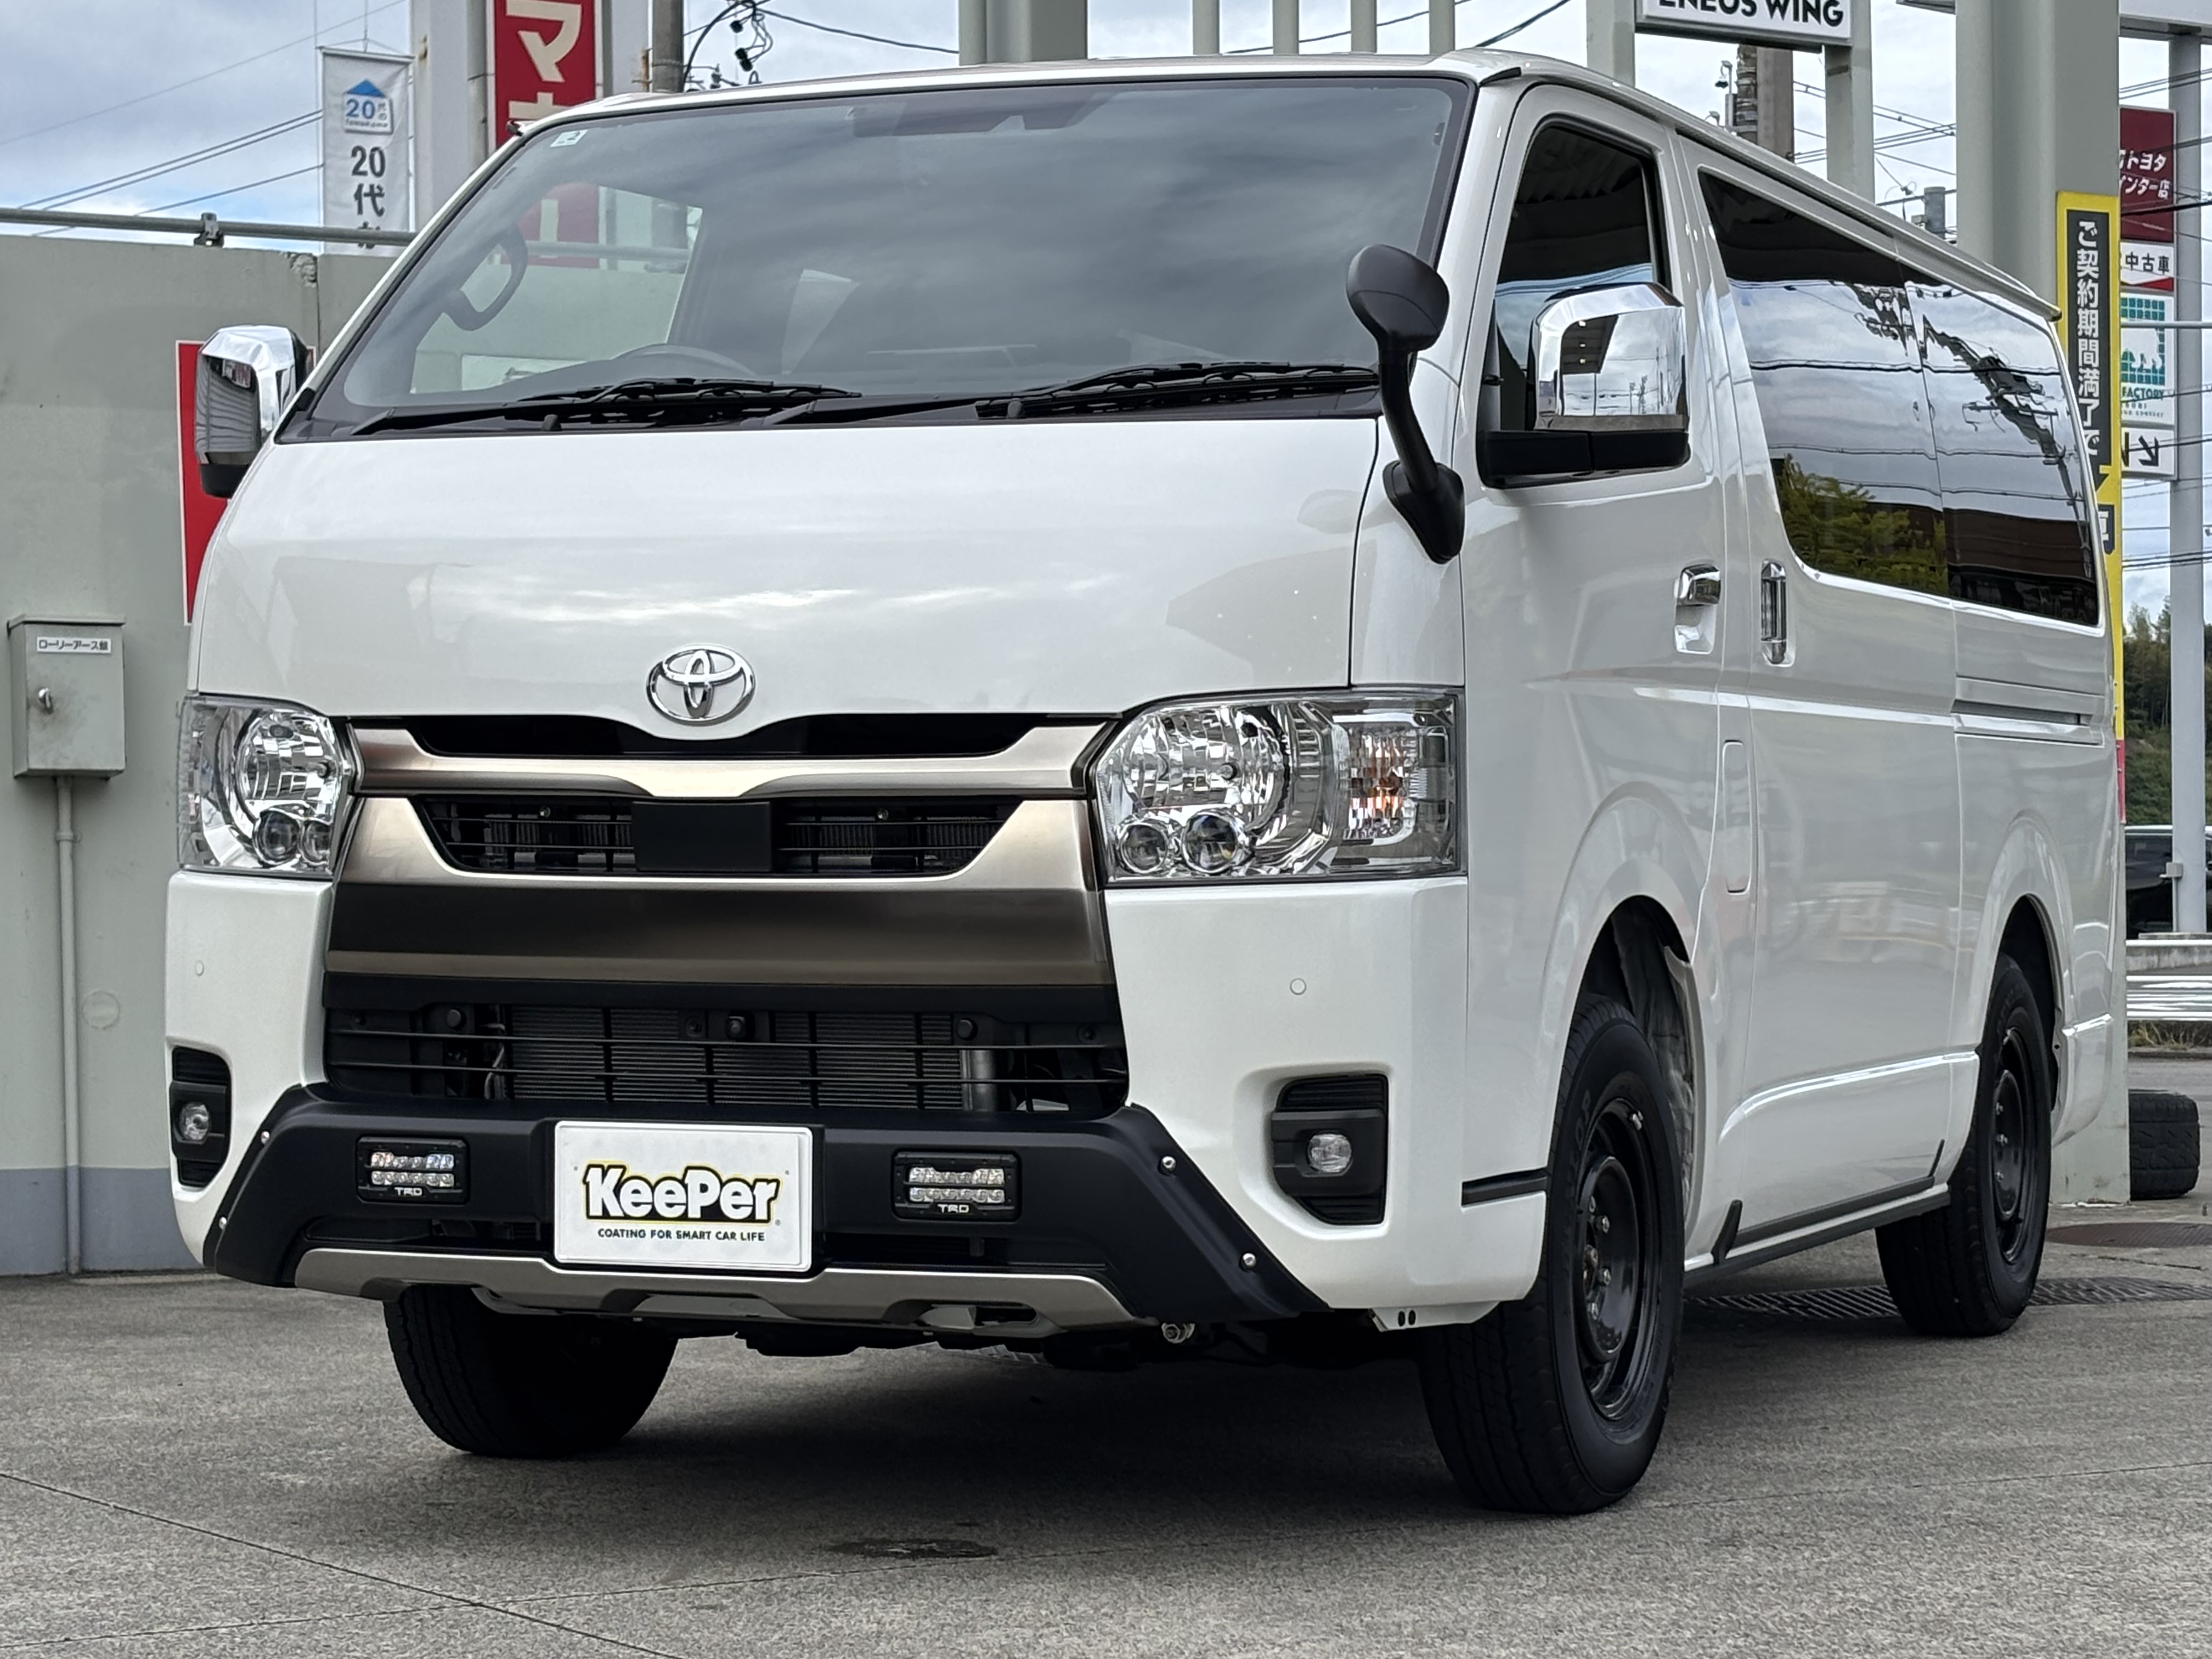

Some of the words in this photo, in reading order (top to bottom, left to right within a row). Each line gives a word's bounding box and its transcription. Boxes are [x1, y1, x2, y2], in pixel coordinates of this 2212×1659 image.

[1659, 0, 1757, 17] EOS
[1765, 0, 1844, 27] WING
[2125, 251, 2170, 274] 中古車
[394, 1187, 422, 1196] TRD
[582, 1163, 781, 1223] KeePer
[937, 1204, 969, 1213] TRD
[598, 1228, 646, 1239] COATING
[651, 1229, 672, 1239] FOR
[676, 1230, 712, 1240] SMART
[715, 1231, 736, 1241] CAR
[740, 1232, 765, 1242] LIFE
